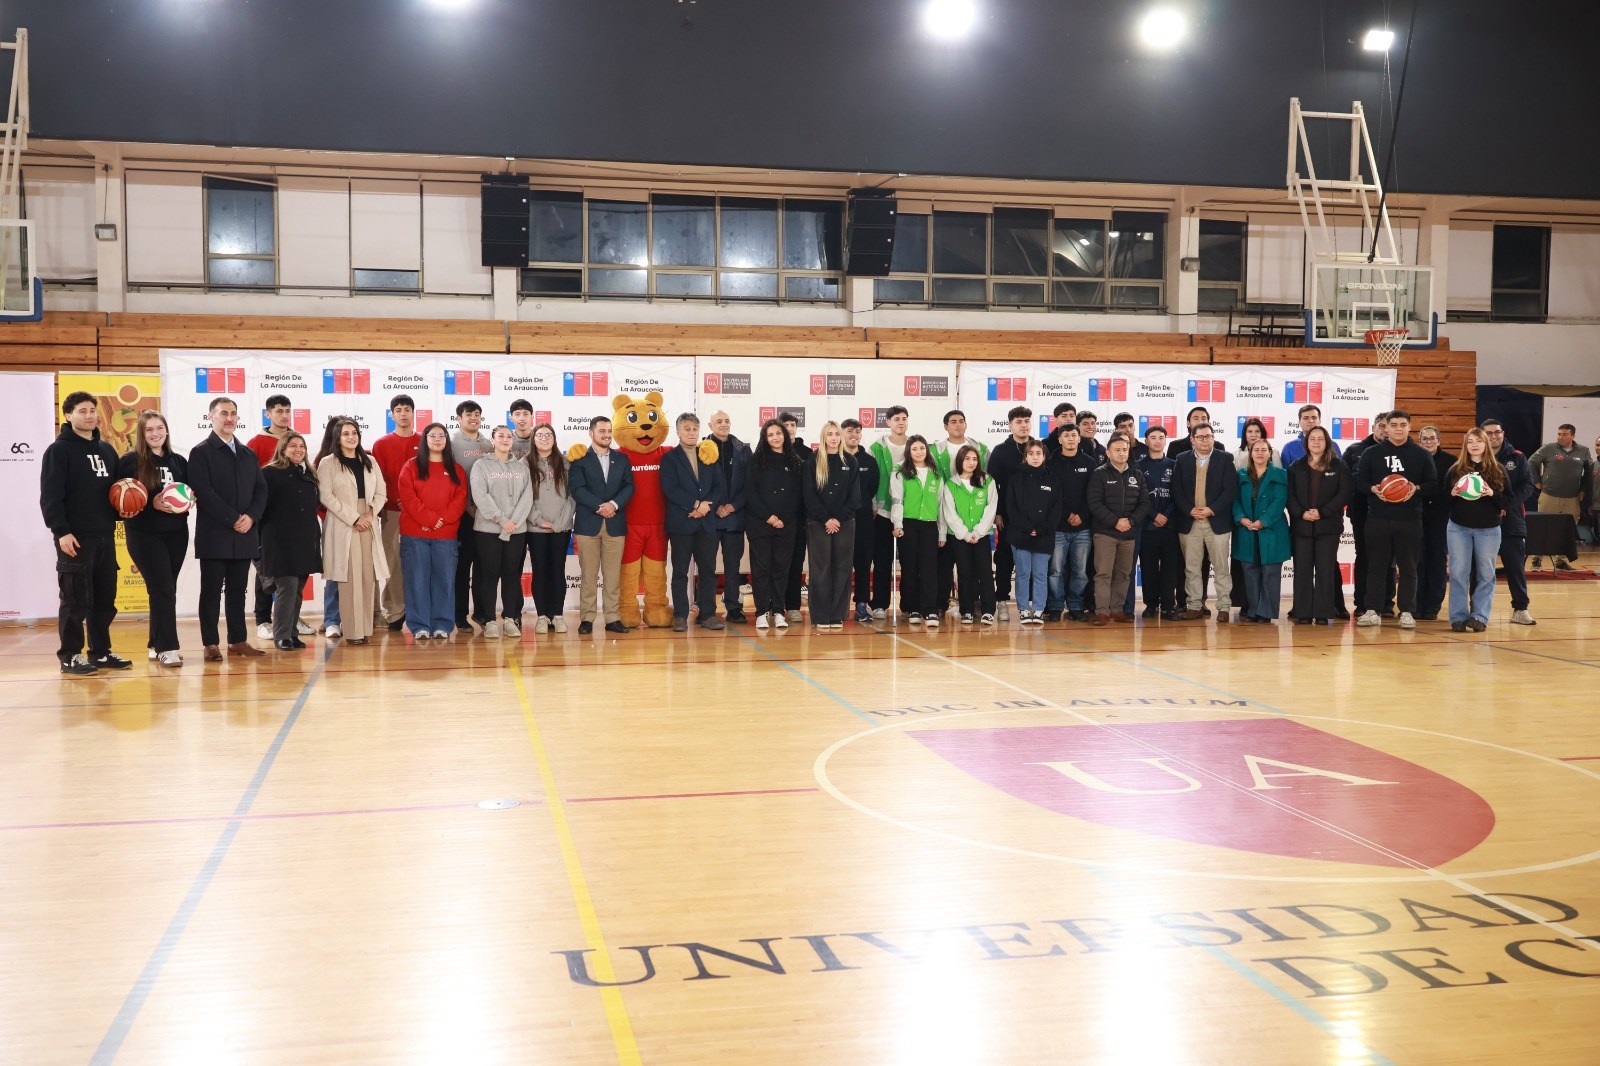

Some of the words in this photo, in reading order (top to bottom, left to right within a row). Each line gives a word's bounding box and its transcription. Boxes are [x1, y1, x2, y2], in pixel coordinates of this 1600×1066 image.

[265, 374, 290, 382] Región
[86, 454, 109, 477] UA
[1384, 456, 1405, 472] UA
[870, 704, 978, 717] DUC
[992, 699, 1046, 708] IN
[550, 892, 1580, 987] UNIVERSIDAD
[1251, 946, 1509, 998] DE
